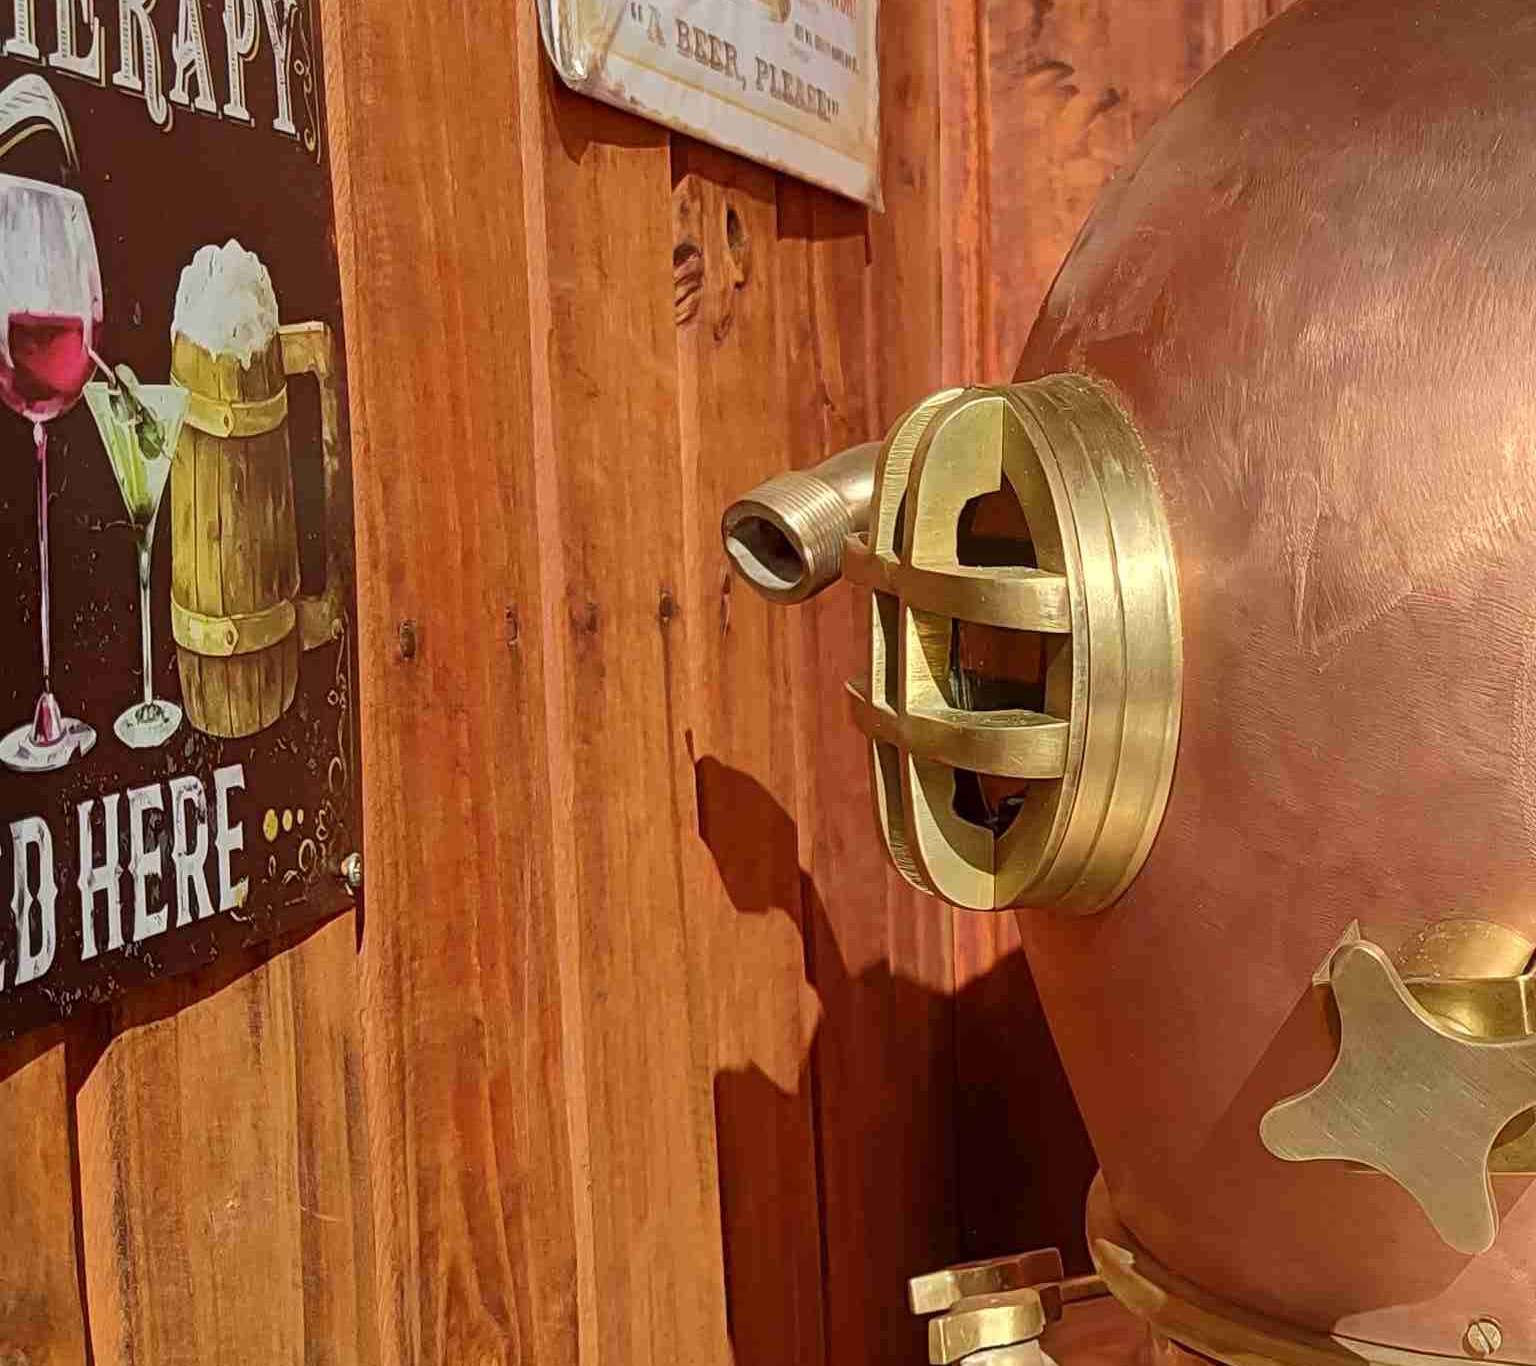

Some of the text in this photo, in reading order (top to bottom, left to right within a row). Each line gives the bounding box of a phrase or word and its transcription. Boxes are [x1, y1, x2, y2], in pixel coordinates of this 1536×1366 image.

[676, 18, 746, 91] BEER,
[0, 763, 249, 991] D HERE
